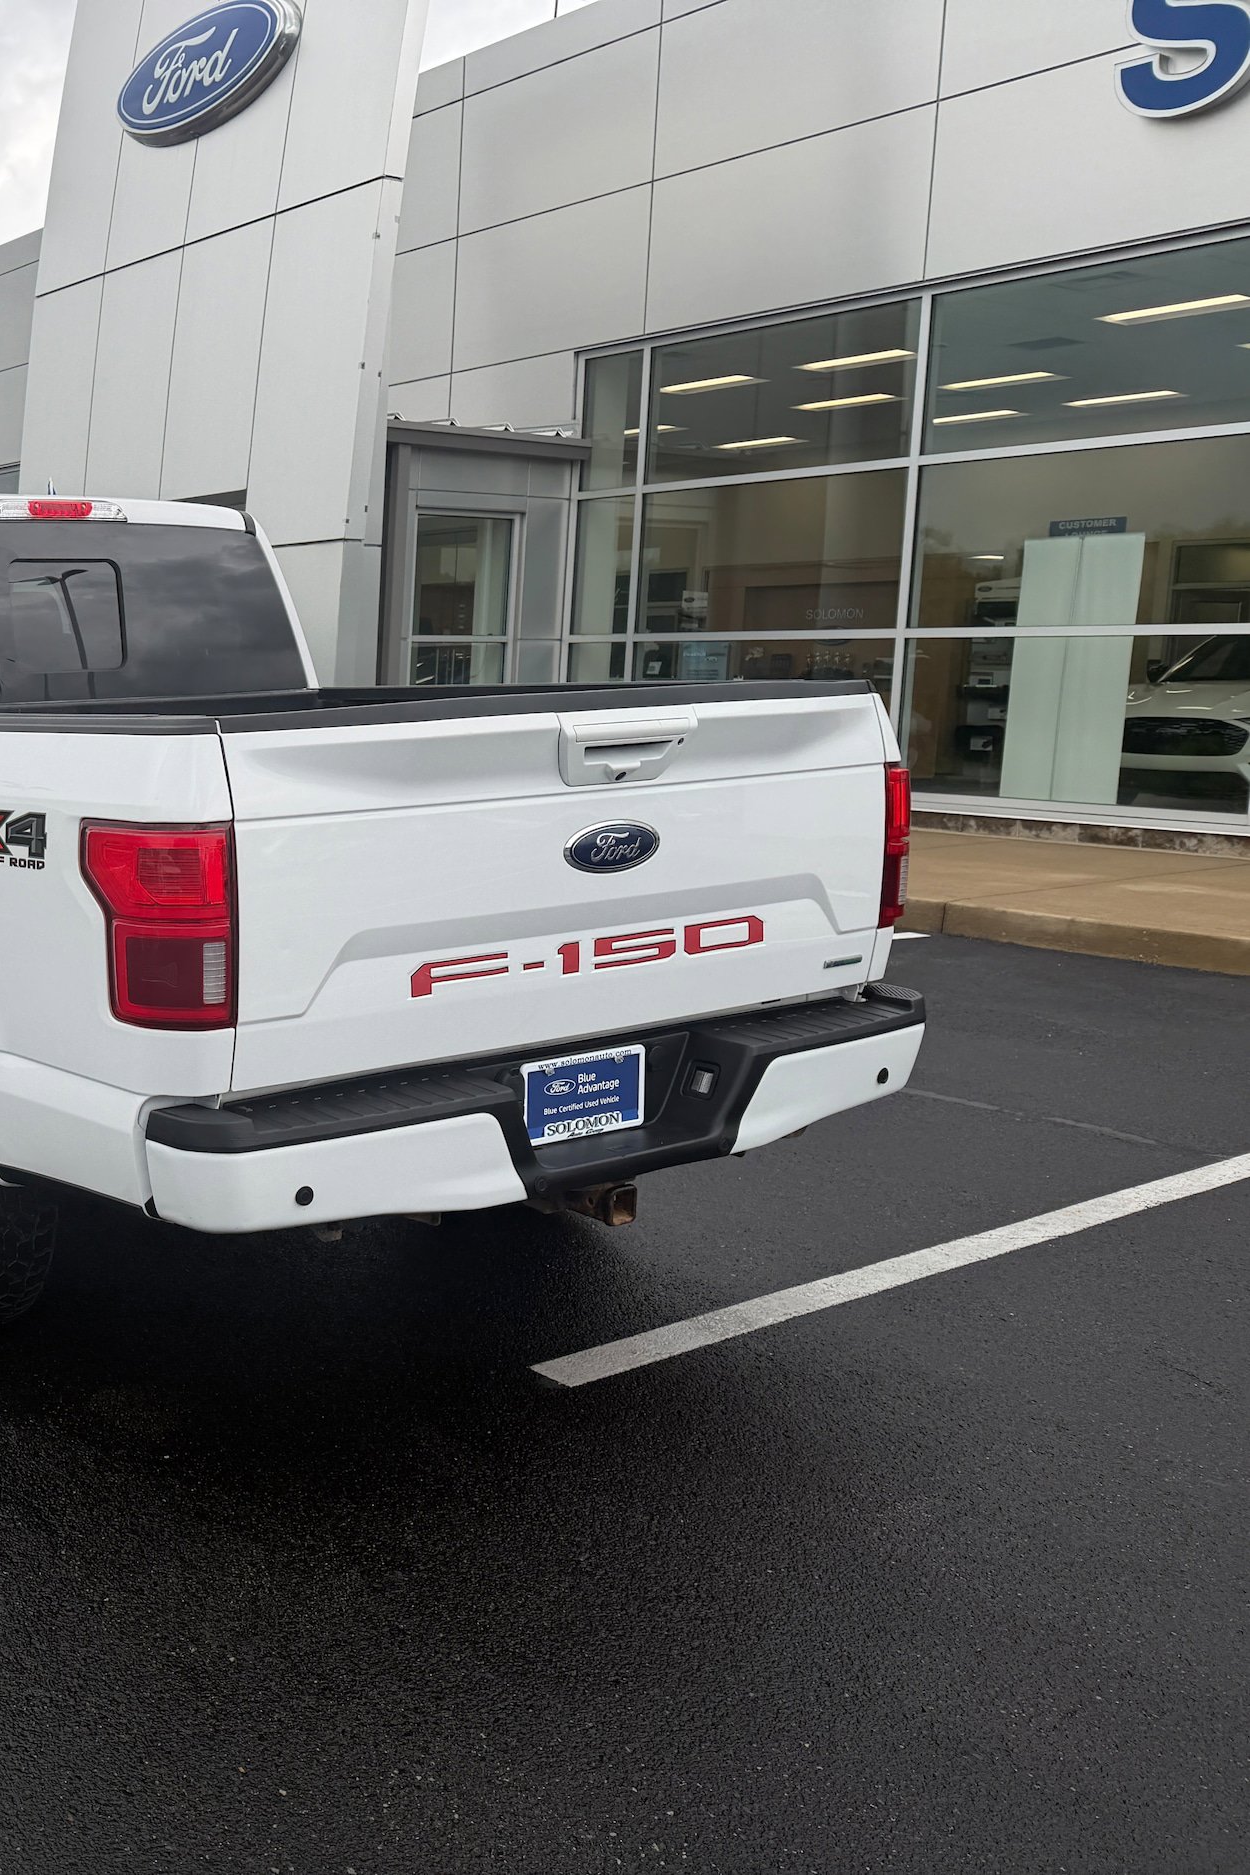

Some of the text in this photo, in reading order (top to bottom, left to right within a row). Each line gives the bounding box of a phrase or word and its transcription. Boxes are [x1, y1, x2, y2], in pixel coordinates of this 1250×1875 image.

[142, 26, 239, 116] Ford
[1059, 519, 1117, 529] CUSTOMER
[805, 607, 864, 620] SOLOMON
[590, 831, 642, 863] Ford
[9, 857, 45, 870] ROAD
[410, 915, 764, 999] F-150
[578, 1073, 596, 1083] Blue
[550, 1082, 570, 1093] Ford
[578, 1079, 620, 1094] Advantage
[559, 1102, 583, 1113] Certified
[585, 1099, 599, 1108] Used
[600, 1095, 620, 1105] Vehicle
[547, 1112, 620, 1136] SOLOMON
